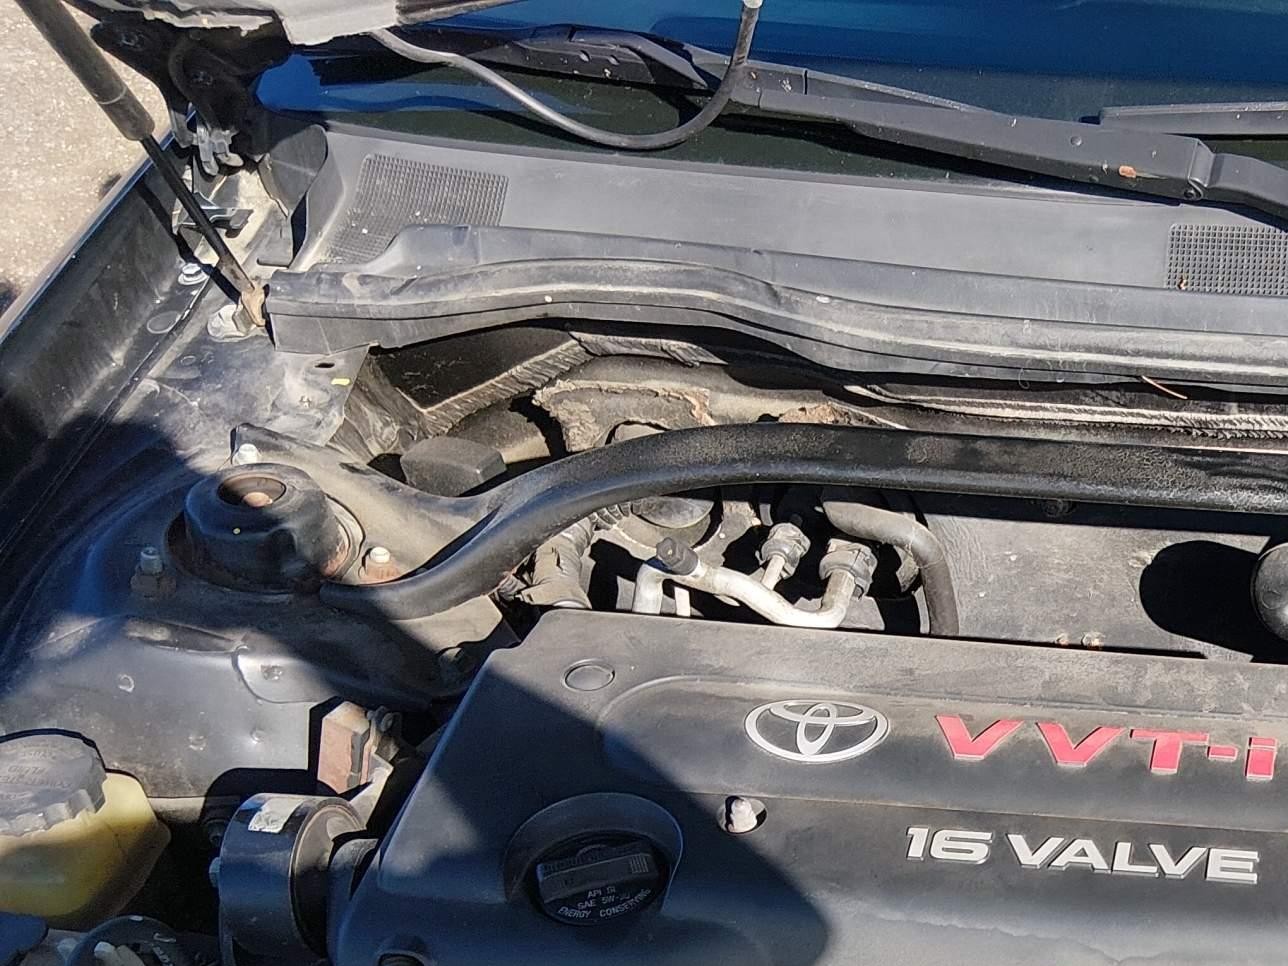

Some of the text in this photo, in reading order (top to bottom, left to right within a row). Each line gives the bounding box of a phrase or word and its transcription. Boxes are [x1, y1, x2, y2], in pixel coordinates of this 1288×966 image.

[934, 713, 1280, 780] VVT-i
[905, 826, 1261, 885] 16 VALVE
